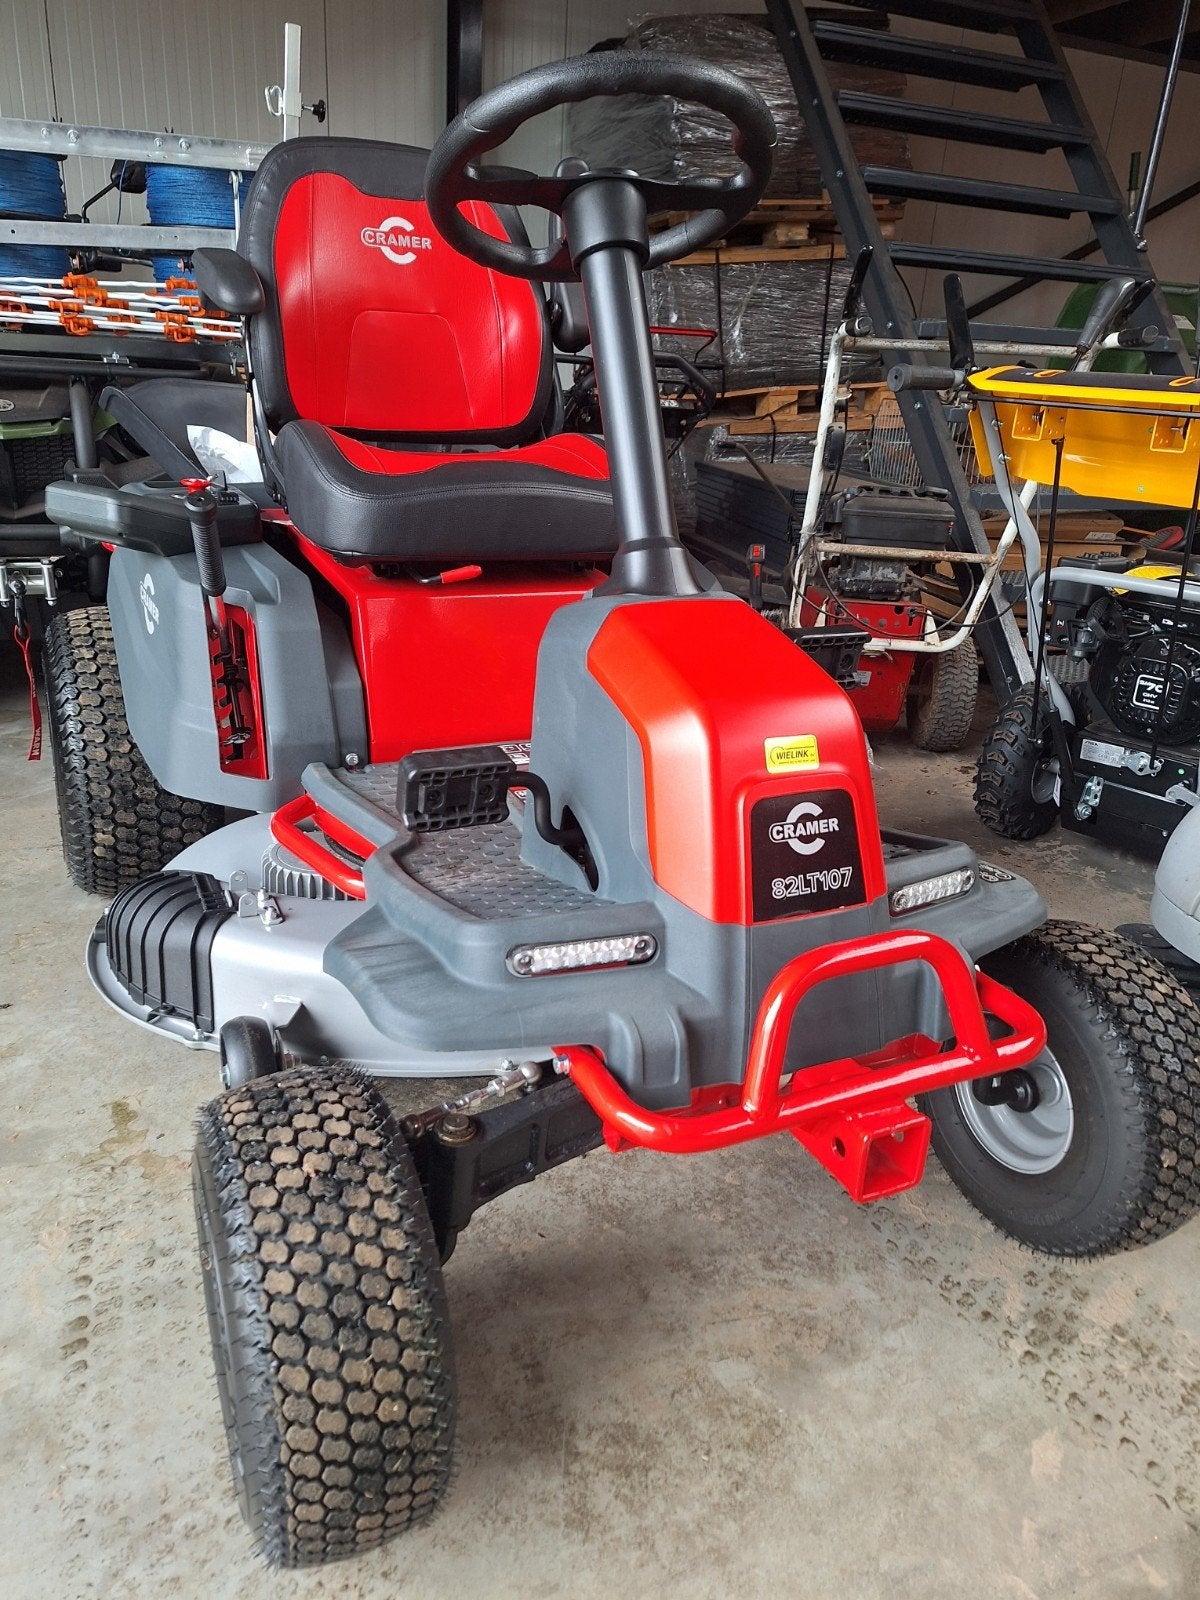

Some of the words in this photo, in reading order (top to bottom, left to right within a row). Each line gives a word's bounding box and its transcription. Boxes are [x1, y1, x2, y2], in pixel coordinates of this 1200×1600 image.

[364, 230, 432, 250] CRAMER
[31, 726, 41, 756] WARN
[776, 749, 809, 760] WIELINK
[772, 818, 840, 840] CRAMER
[771, 866, 853, 899] 82LT107
